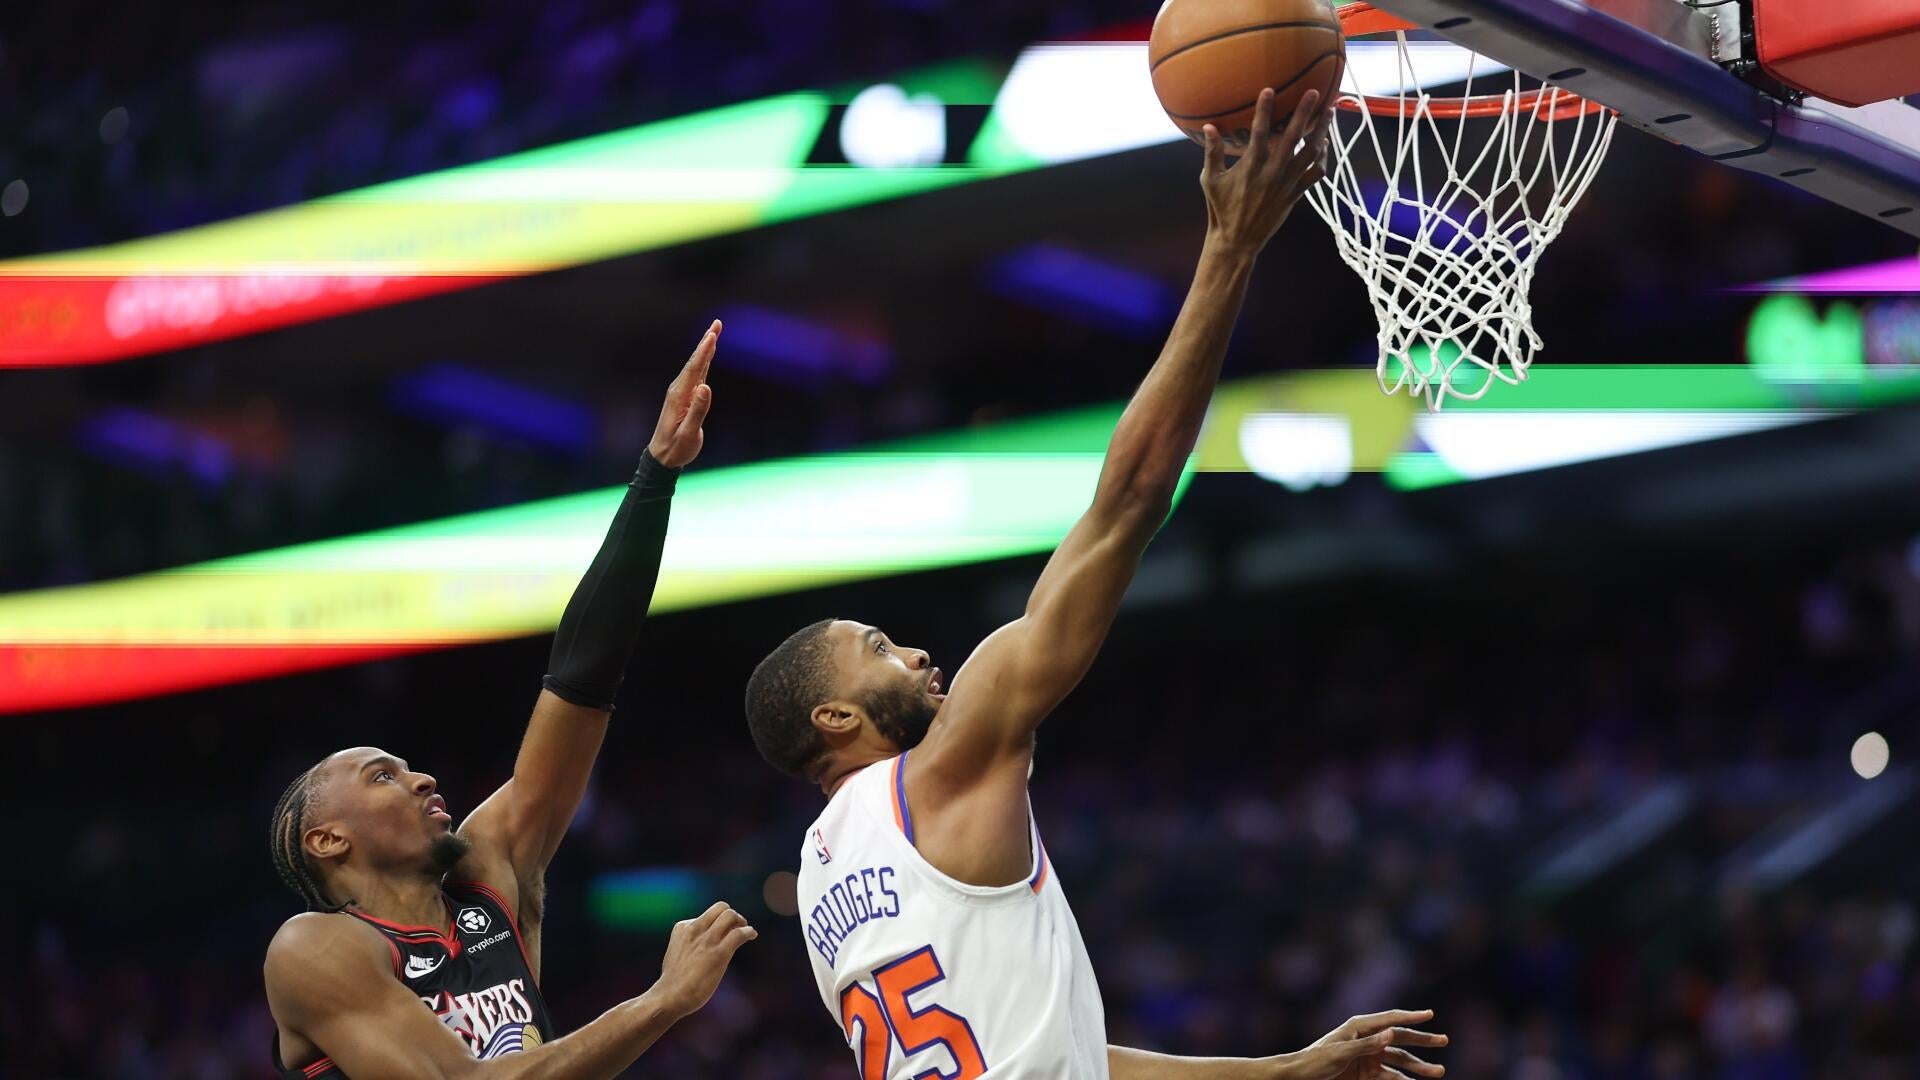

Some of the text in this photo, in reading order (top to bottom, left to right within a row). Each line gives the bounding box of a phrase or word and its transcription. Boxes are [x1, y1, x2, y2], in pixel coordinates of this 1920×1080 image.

[467, 929, 511, 954] crypto.com
[808, 866, 900, 970] BRIDGES
[409, 955, 434, 970] NIKE
[419, 978, 533, 1058] XERS
[840, 944, 988, 1080] 25
